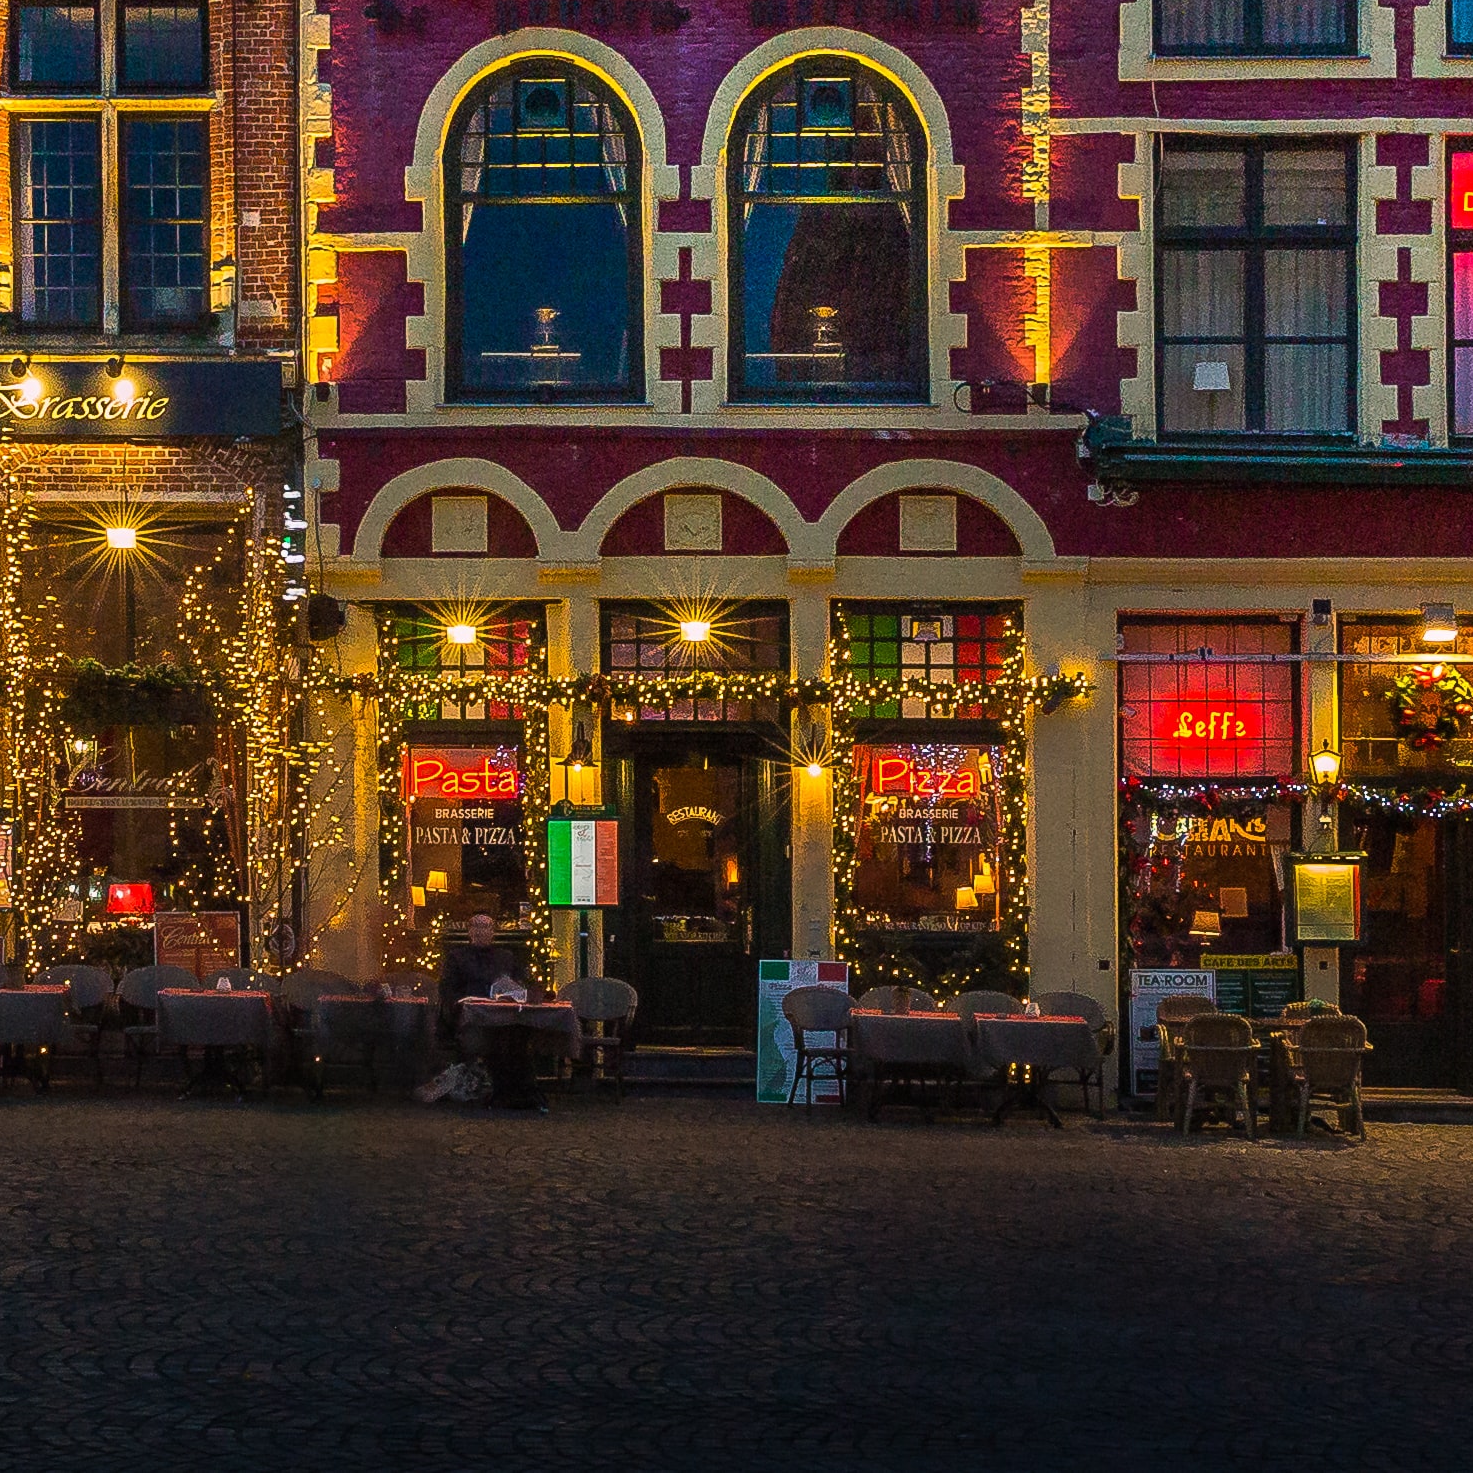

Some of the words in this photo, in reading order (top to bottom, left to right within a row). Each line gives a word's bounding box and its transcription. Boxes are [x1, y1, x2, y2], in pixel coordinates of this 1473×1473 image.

[1172, 711, 1247, 740] Leffe
[413, 757, 516, 794] Pasta
[878, 758, 975, 794] Pizza
[435, 808, 495, 819] BRASSERIE
[666, 806, 726, 825] RESTAURANT
[898, 808, 959, 819] BRASSERIE
[416, 827, 458, 845] PASTA
[461, 828, 472, 845] &
[475, 827, 515, 845] PIZZA
[880, 826, 924, 844] PASTA
[926, 828, 937, 844] &
[940, 826, 982, 844] PIZZA
[1149, 844, 1267, 858] RESTAURANT
[1236, 956, 1260, 967] DES
[1262, 955, 1295, 967] ARTS
[1137, 974, 1208, 987] TEA-ROOM
